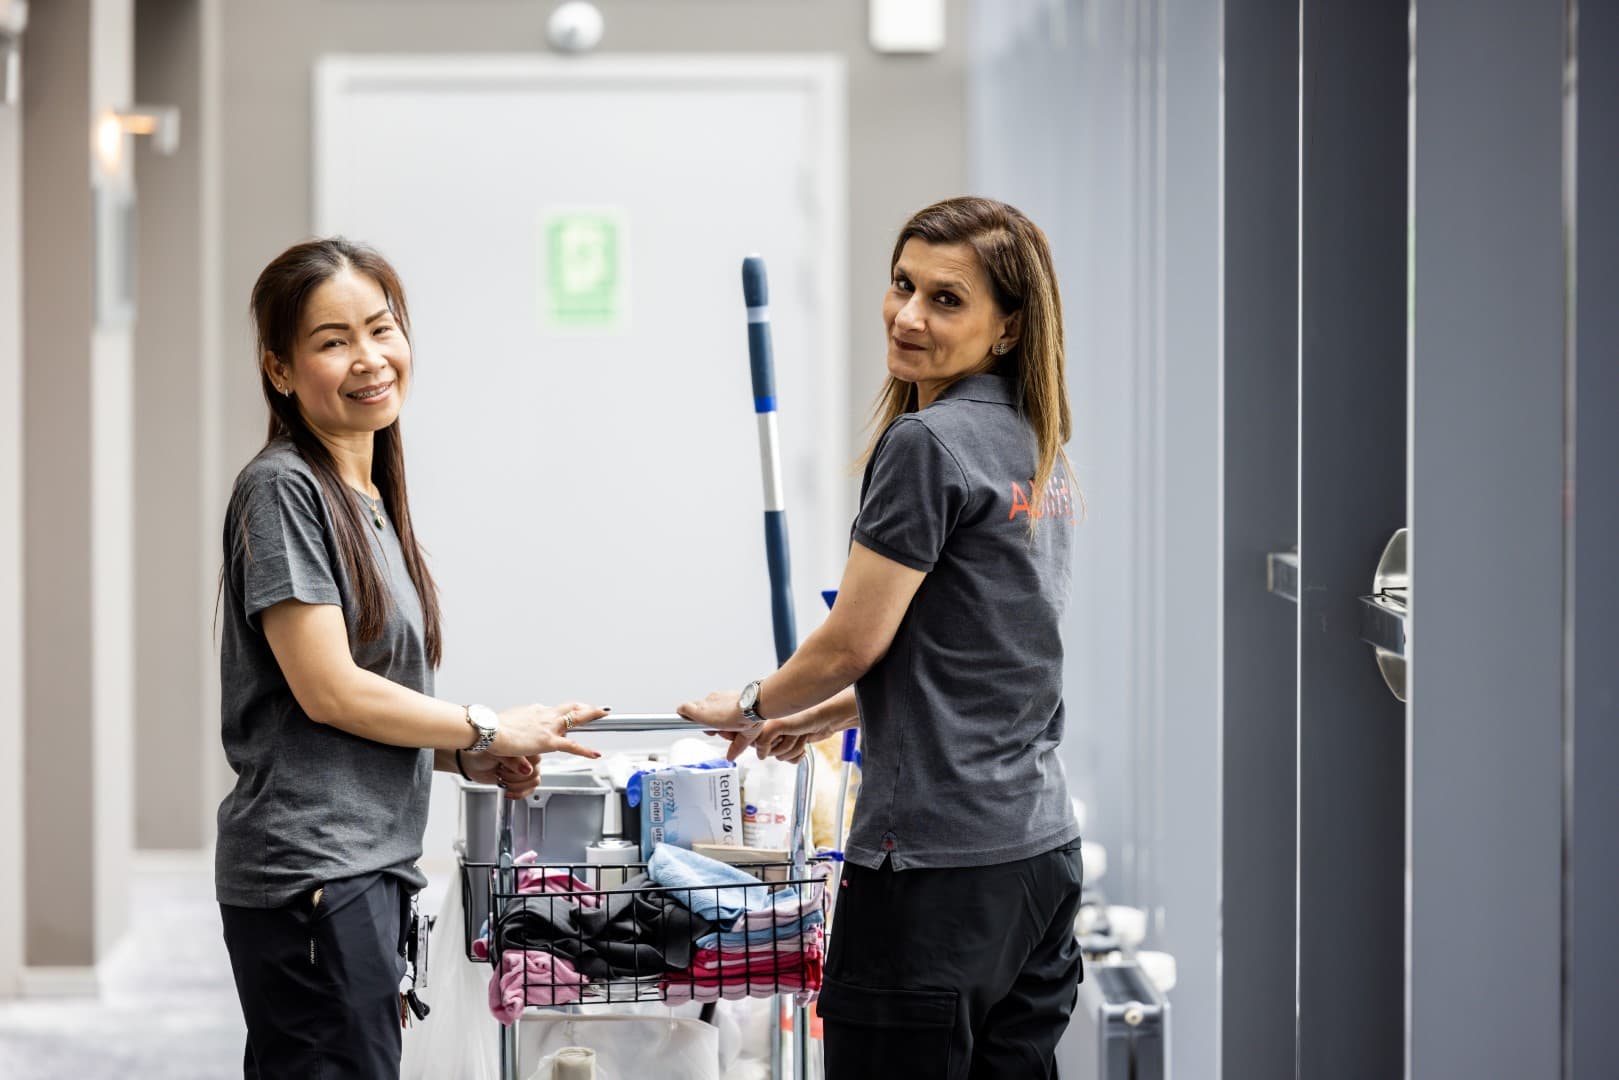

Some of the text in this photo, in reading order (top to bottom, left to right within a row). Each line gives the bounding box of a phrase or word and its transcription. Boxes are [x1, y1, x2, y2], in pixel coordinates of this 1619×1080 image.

[653, 781, 661, 797] 200
[720, 774, 735, 820] tender
[653, 802, 662, 822] nitril
